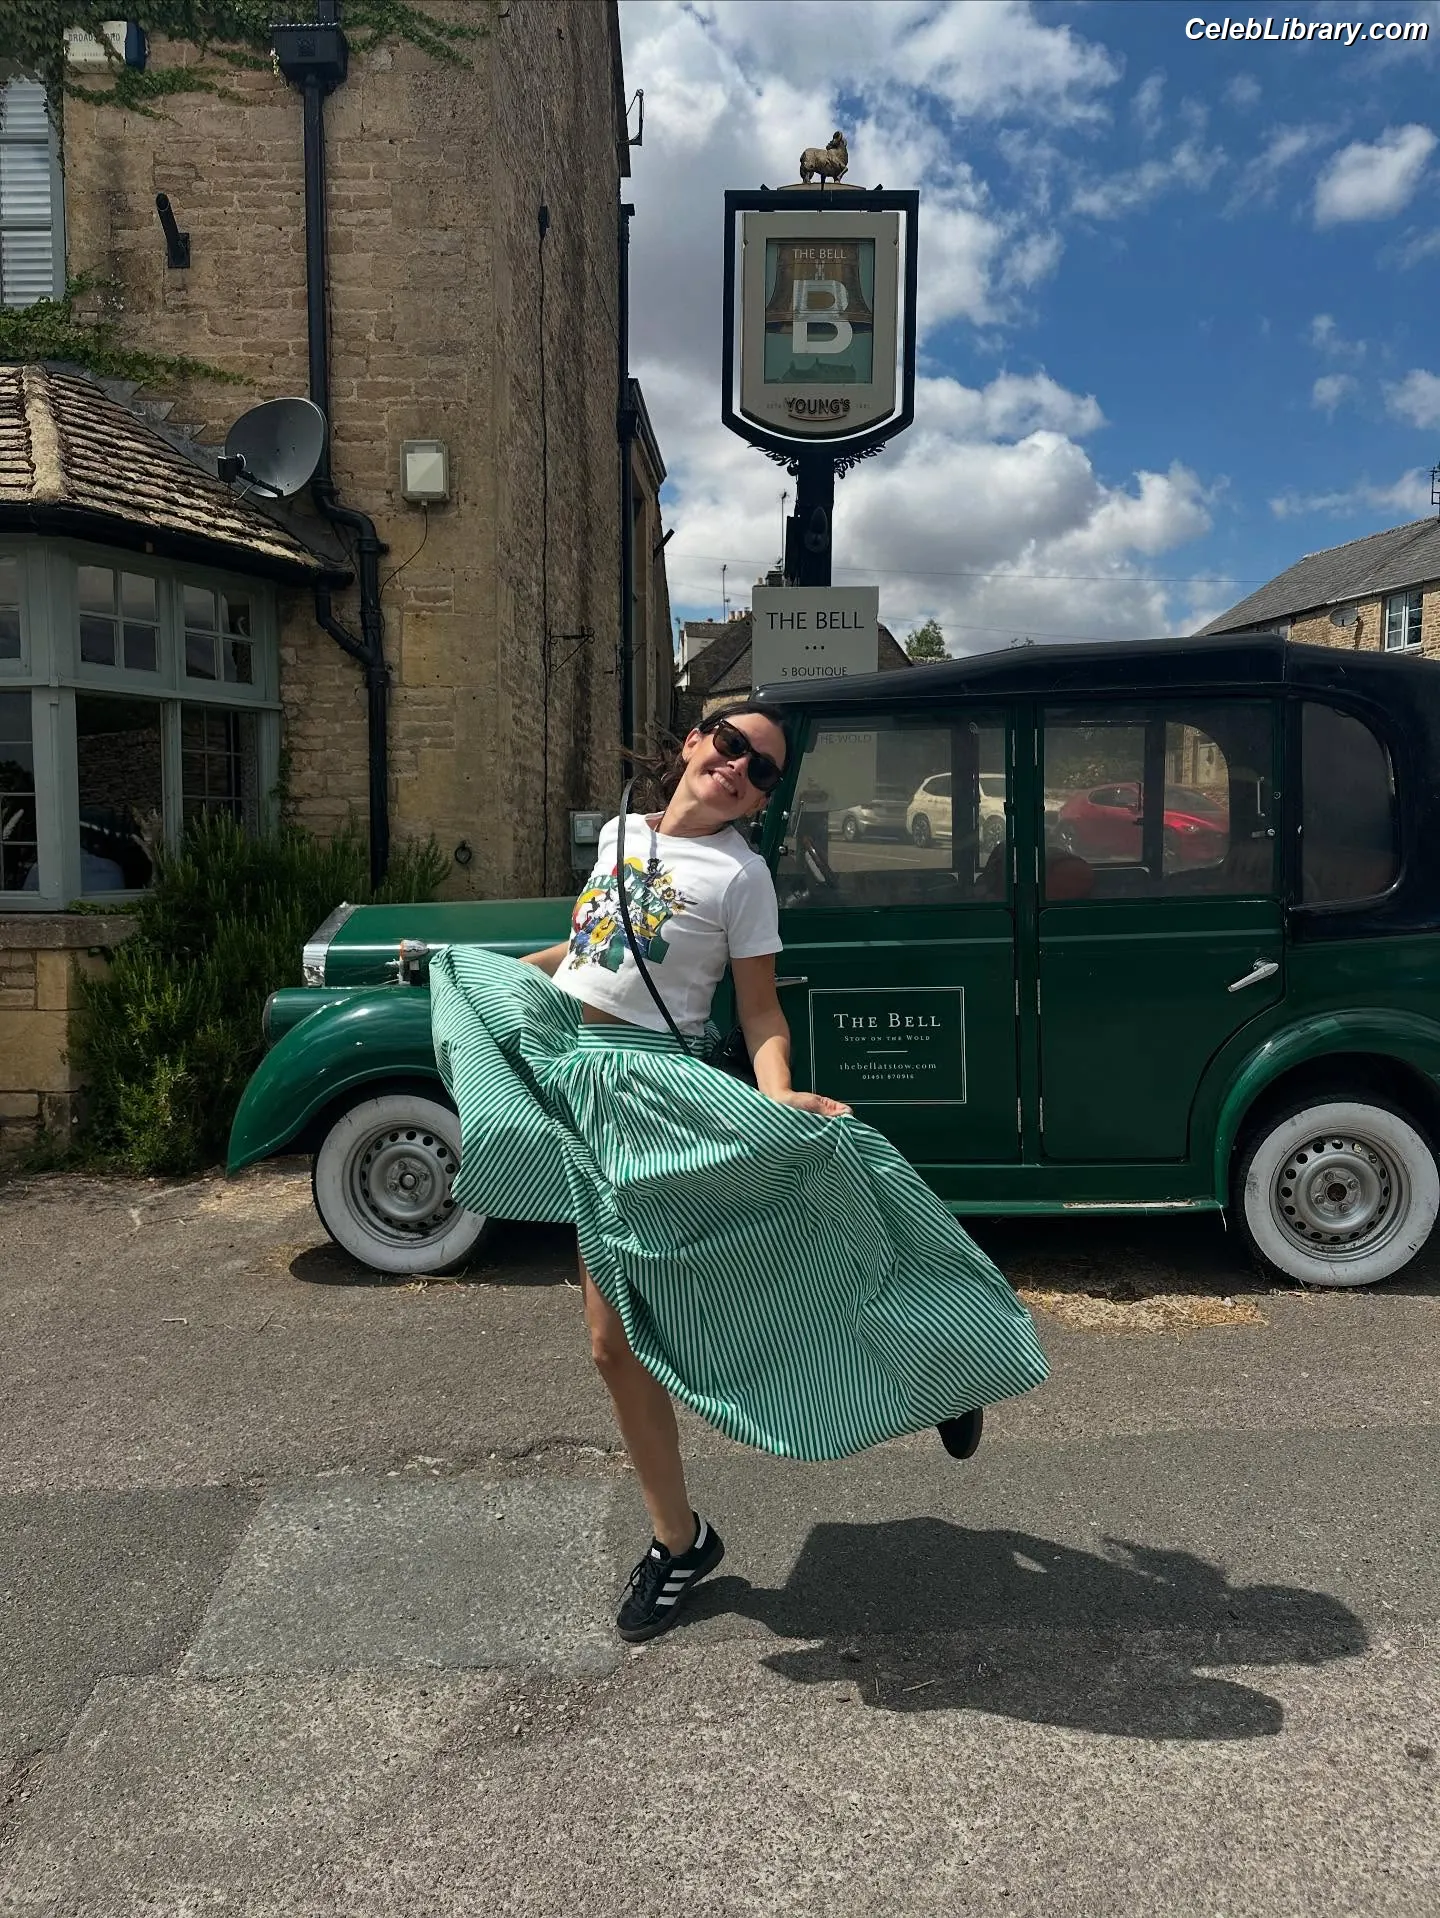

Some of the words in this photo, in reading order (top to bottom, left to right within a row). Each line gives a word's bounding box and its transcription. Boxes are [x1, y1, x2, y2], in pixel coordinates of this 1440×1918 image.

[792, 248, 815, 259] THE
[819, 248, 847, 259] BELL
[792, 280, 853, 354] B
[785, 396, 851, 415] YOUNG'S
[766, 611, 807, 630] THE
[816, 611, 864, 629] BELL
[781, 667, 789, 677] 5
[791, 666, 848, 677] BOUTIQUE
[833, 1013, 878, 1029] THE
[888, 1012, 941, 1028] BELL
[839, 1062, 937, 1071] thebellatstow.com
